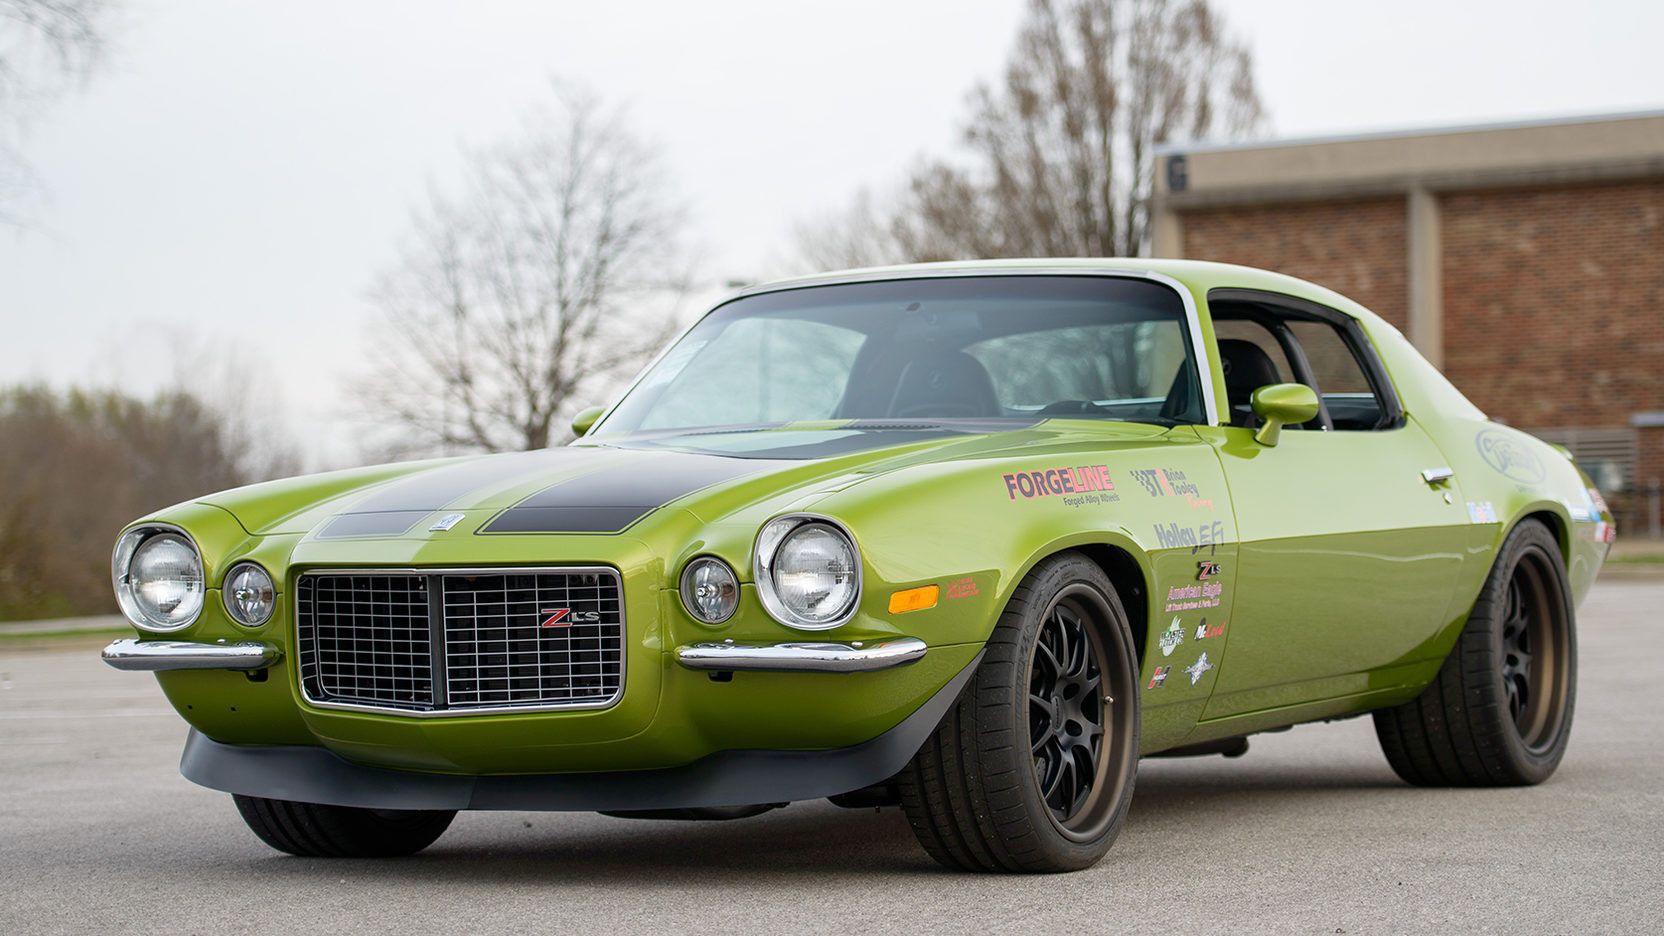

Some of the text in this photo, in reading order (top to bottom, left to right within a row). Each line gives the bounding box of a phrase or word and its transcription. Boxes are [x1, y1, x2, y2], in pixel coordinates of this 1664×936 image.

[1002, 464, 1115, 501] FORGELINE
[1169, 482, 1200, 498] Tooley
[1063, 496, 1085, 508] Forged
[1085, 495, 1100, 505] Alloy
[1153, 521, 1224, 556] Holley EFI
[1167, 584, 1202, 601] American
[1194, 621, 1226, 641] McLeod
